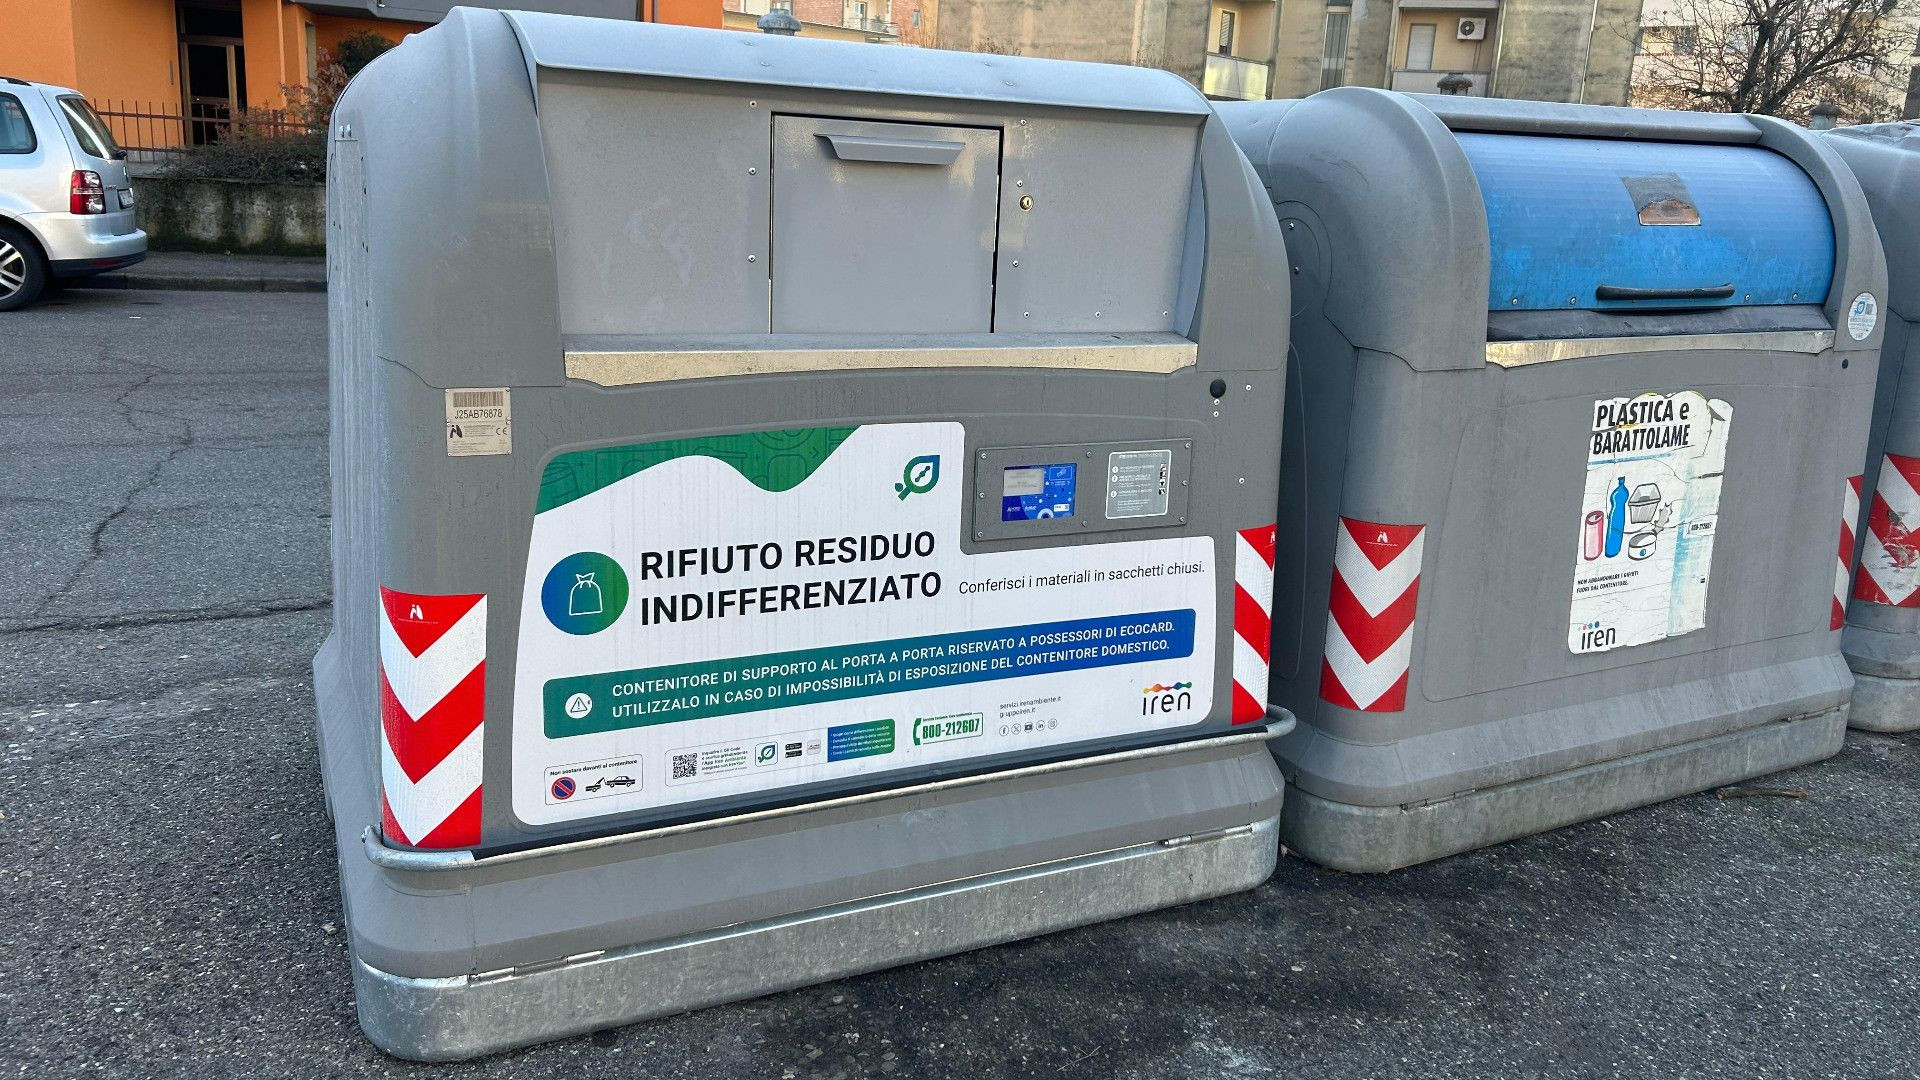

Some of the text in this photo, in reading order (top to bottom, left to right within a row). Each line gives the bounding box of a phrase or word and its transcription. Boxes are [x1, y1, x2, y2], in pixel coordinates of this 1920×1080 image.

[455, 409, 502, 419] J25AB76878
[1596, 400, 1690, 427] PLASTICA e
[1593, 424, 1691, 455] BARATTOLAME
[641, 530, 935, 580] RIFIUTO RESIDUO
[959, 561, 1205, 594] Conferisci i materiali in sacchetti chiusi.
[641, 571, 942, 625] INDIFFERENZIATO
[1581, 628, 1616, 650] iren
[612, 622, 1175, 697] CONTENITORE DI SUPPORTO AL PORTA A PORTA RISERVATO A POSSESSORI DI ECOCARD.
[612, 639, 1170, 718] UTILIZZALO IN CASO DI IMPOSSIBILITÀ DI ESPOSIZIONE DEL CONTENITORE DOMESTICO.
[1143, 691, 1191, 716] iren
[923, 718, 980, 739] 800-212607
